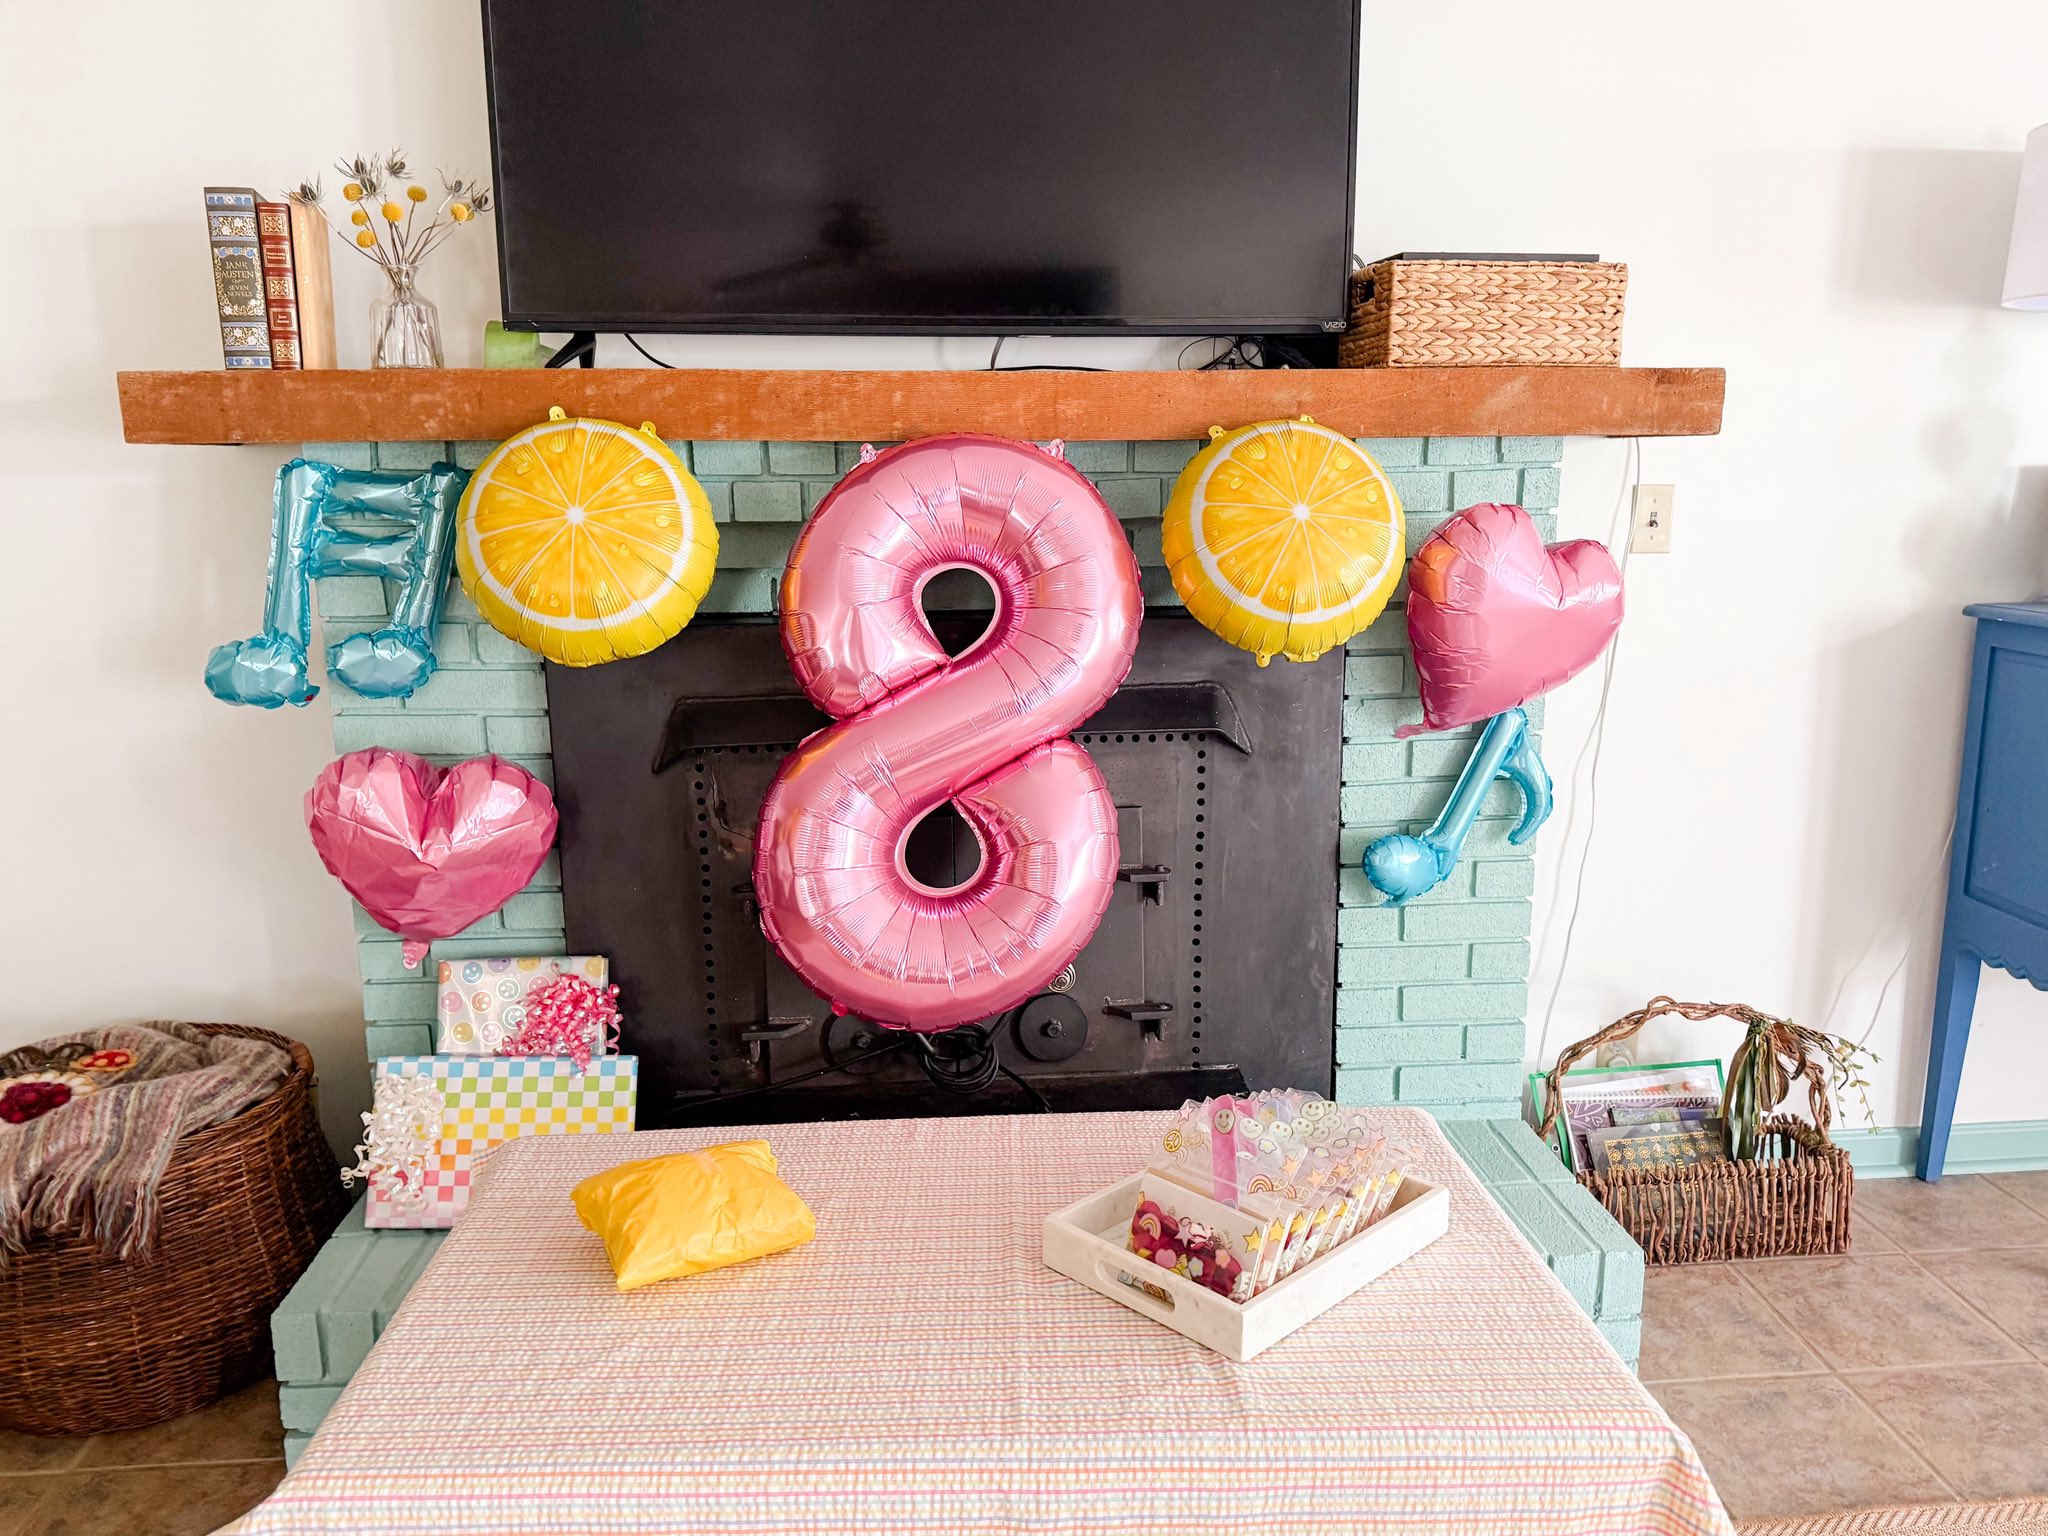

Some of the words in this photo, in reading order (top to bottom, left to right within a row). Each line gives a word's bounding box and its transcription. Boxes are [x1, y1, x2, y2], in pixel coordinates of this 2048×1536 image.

[226, 261, 247, 269] JANE
[221, 270, 254, 278] AUSTEN
[753, 432, 1144, 1032] 8
